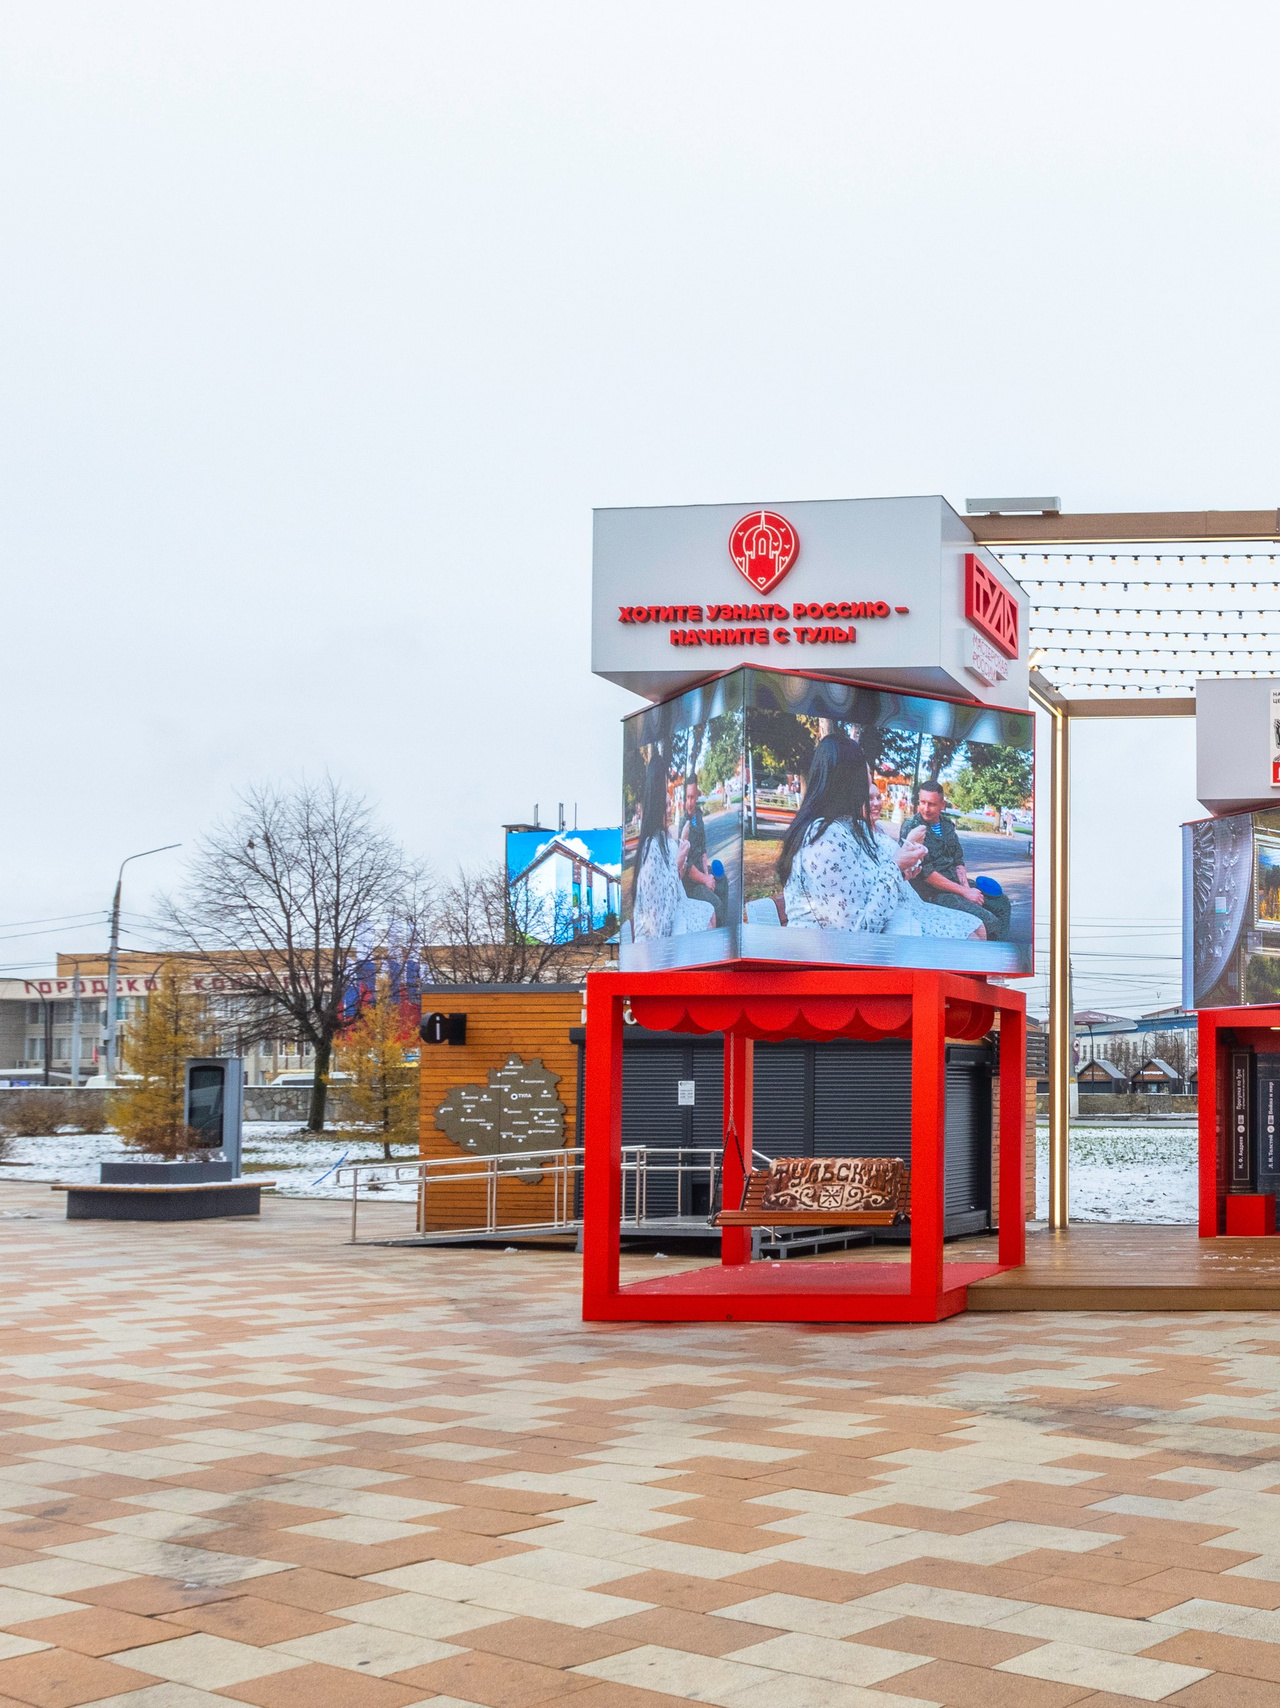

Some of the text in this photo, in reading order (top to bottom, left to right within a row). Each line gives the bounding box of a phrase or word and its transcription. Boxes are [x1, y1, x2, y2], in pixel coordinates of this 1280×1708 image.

[618, 605, 703, 623] ХОТИТЕ
[706, 603, 789, 621] УЗНАТЬ
[792, 601, 890, 619] РОССИЮ
[670, 626, 856, 646] НАЧНИТЕ С ТУЛЫ
